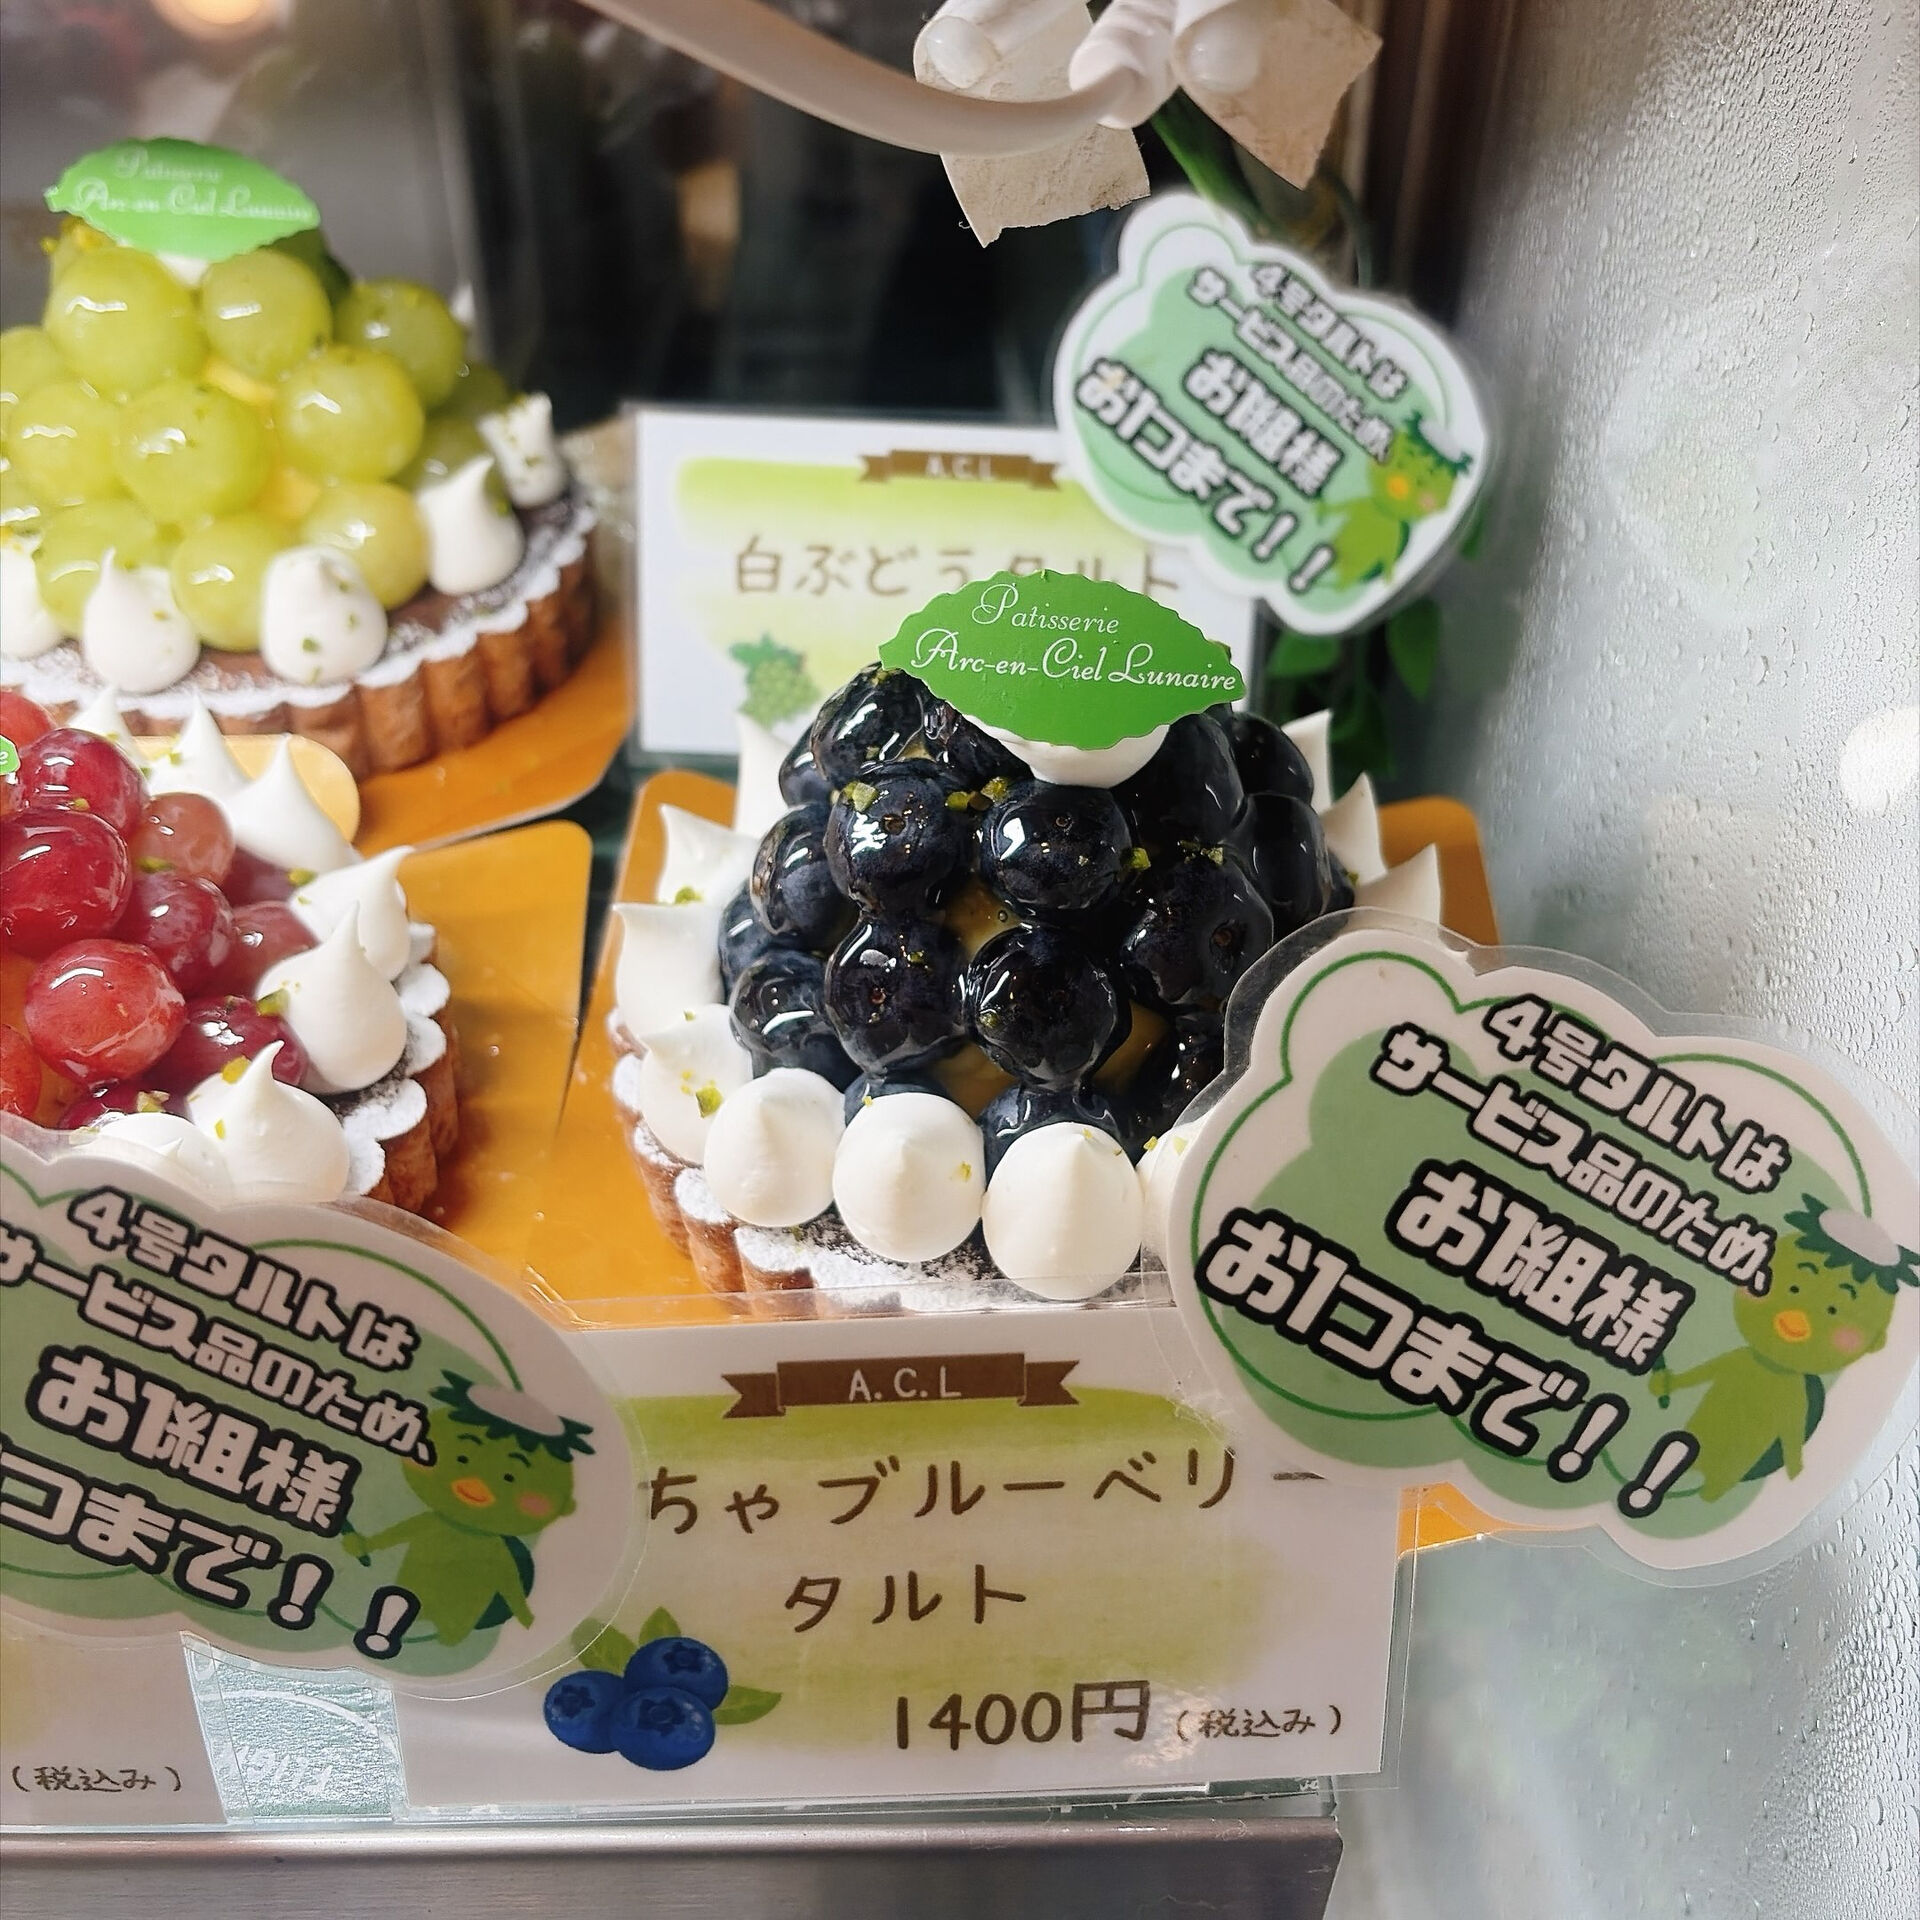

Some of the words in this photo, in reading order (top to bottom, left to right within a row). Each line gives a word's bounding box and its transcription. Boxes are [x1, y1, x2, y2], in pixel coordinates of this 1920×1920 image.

[1251, 262, 1408, 402] 4号タルトは
[971, 582, 1119, 634] Patisserie
[911, 627, 1103, 682] Arc-en-Ciel
[1108, 643, 1236, 691] Lunaire
[1483, 992, 1791, 1196] 4号タルトは
[1370, 1022, 1774, 1296] サービス品のため、
[67, 1185, 421, 1374] 4号タルトは
[849, 1366, 962, 1401] A.C.L
[784, 1564, 1026, 1633] タルト
[896, 1680, 1150, 1750] 1400円
